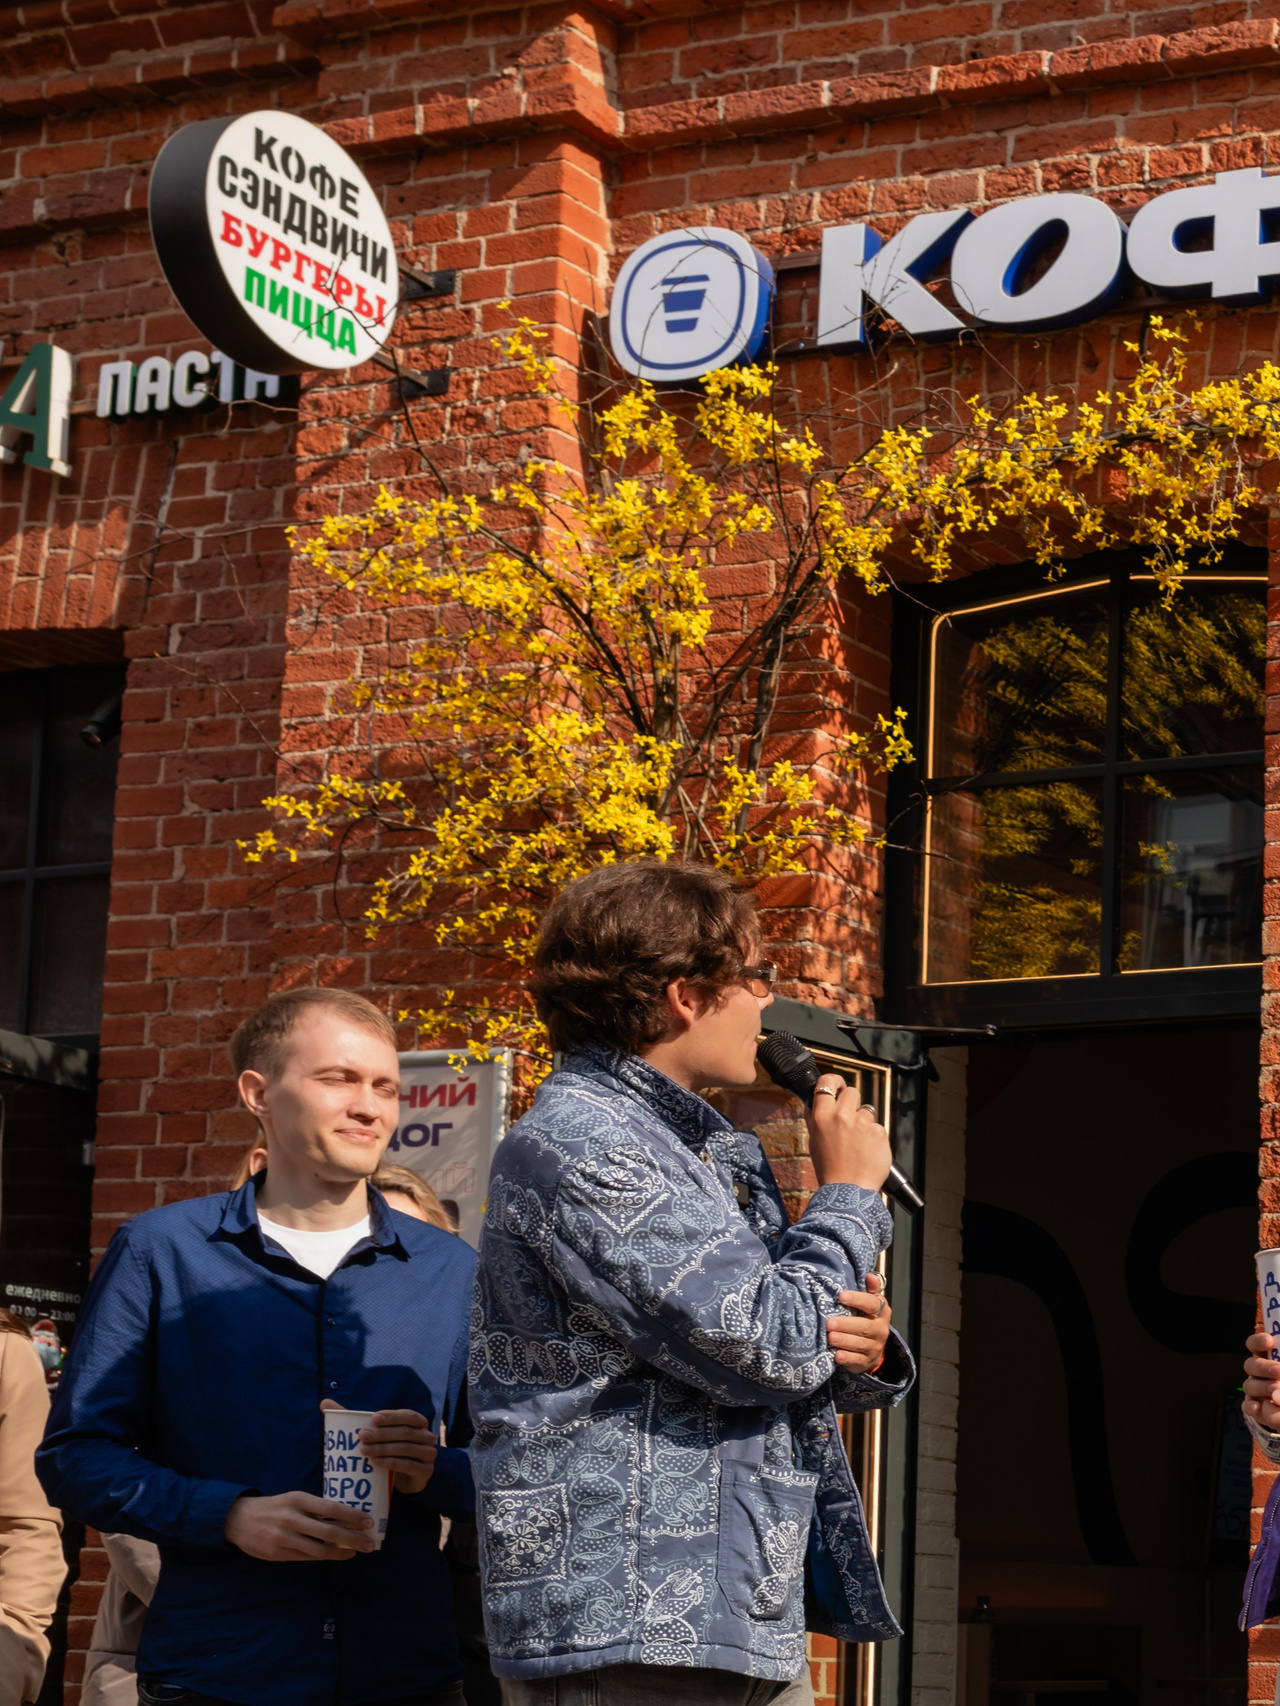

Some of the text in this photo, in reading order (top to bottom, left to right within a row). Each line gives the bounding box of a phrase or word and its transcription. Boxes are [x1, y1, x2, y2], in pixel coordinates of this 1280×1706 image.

[217, 155, 388, 285] СЭНДВИЧИ
[254, 127, 359, 220] КОФЕ
[220, 210, 387, 328] БУРГЕРЫ
[244, 265, 357, 357] ПИЦЦА
[5, 1284, 81, 1304] ежедневно
